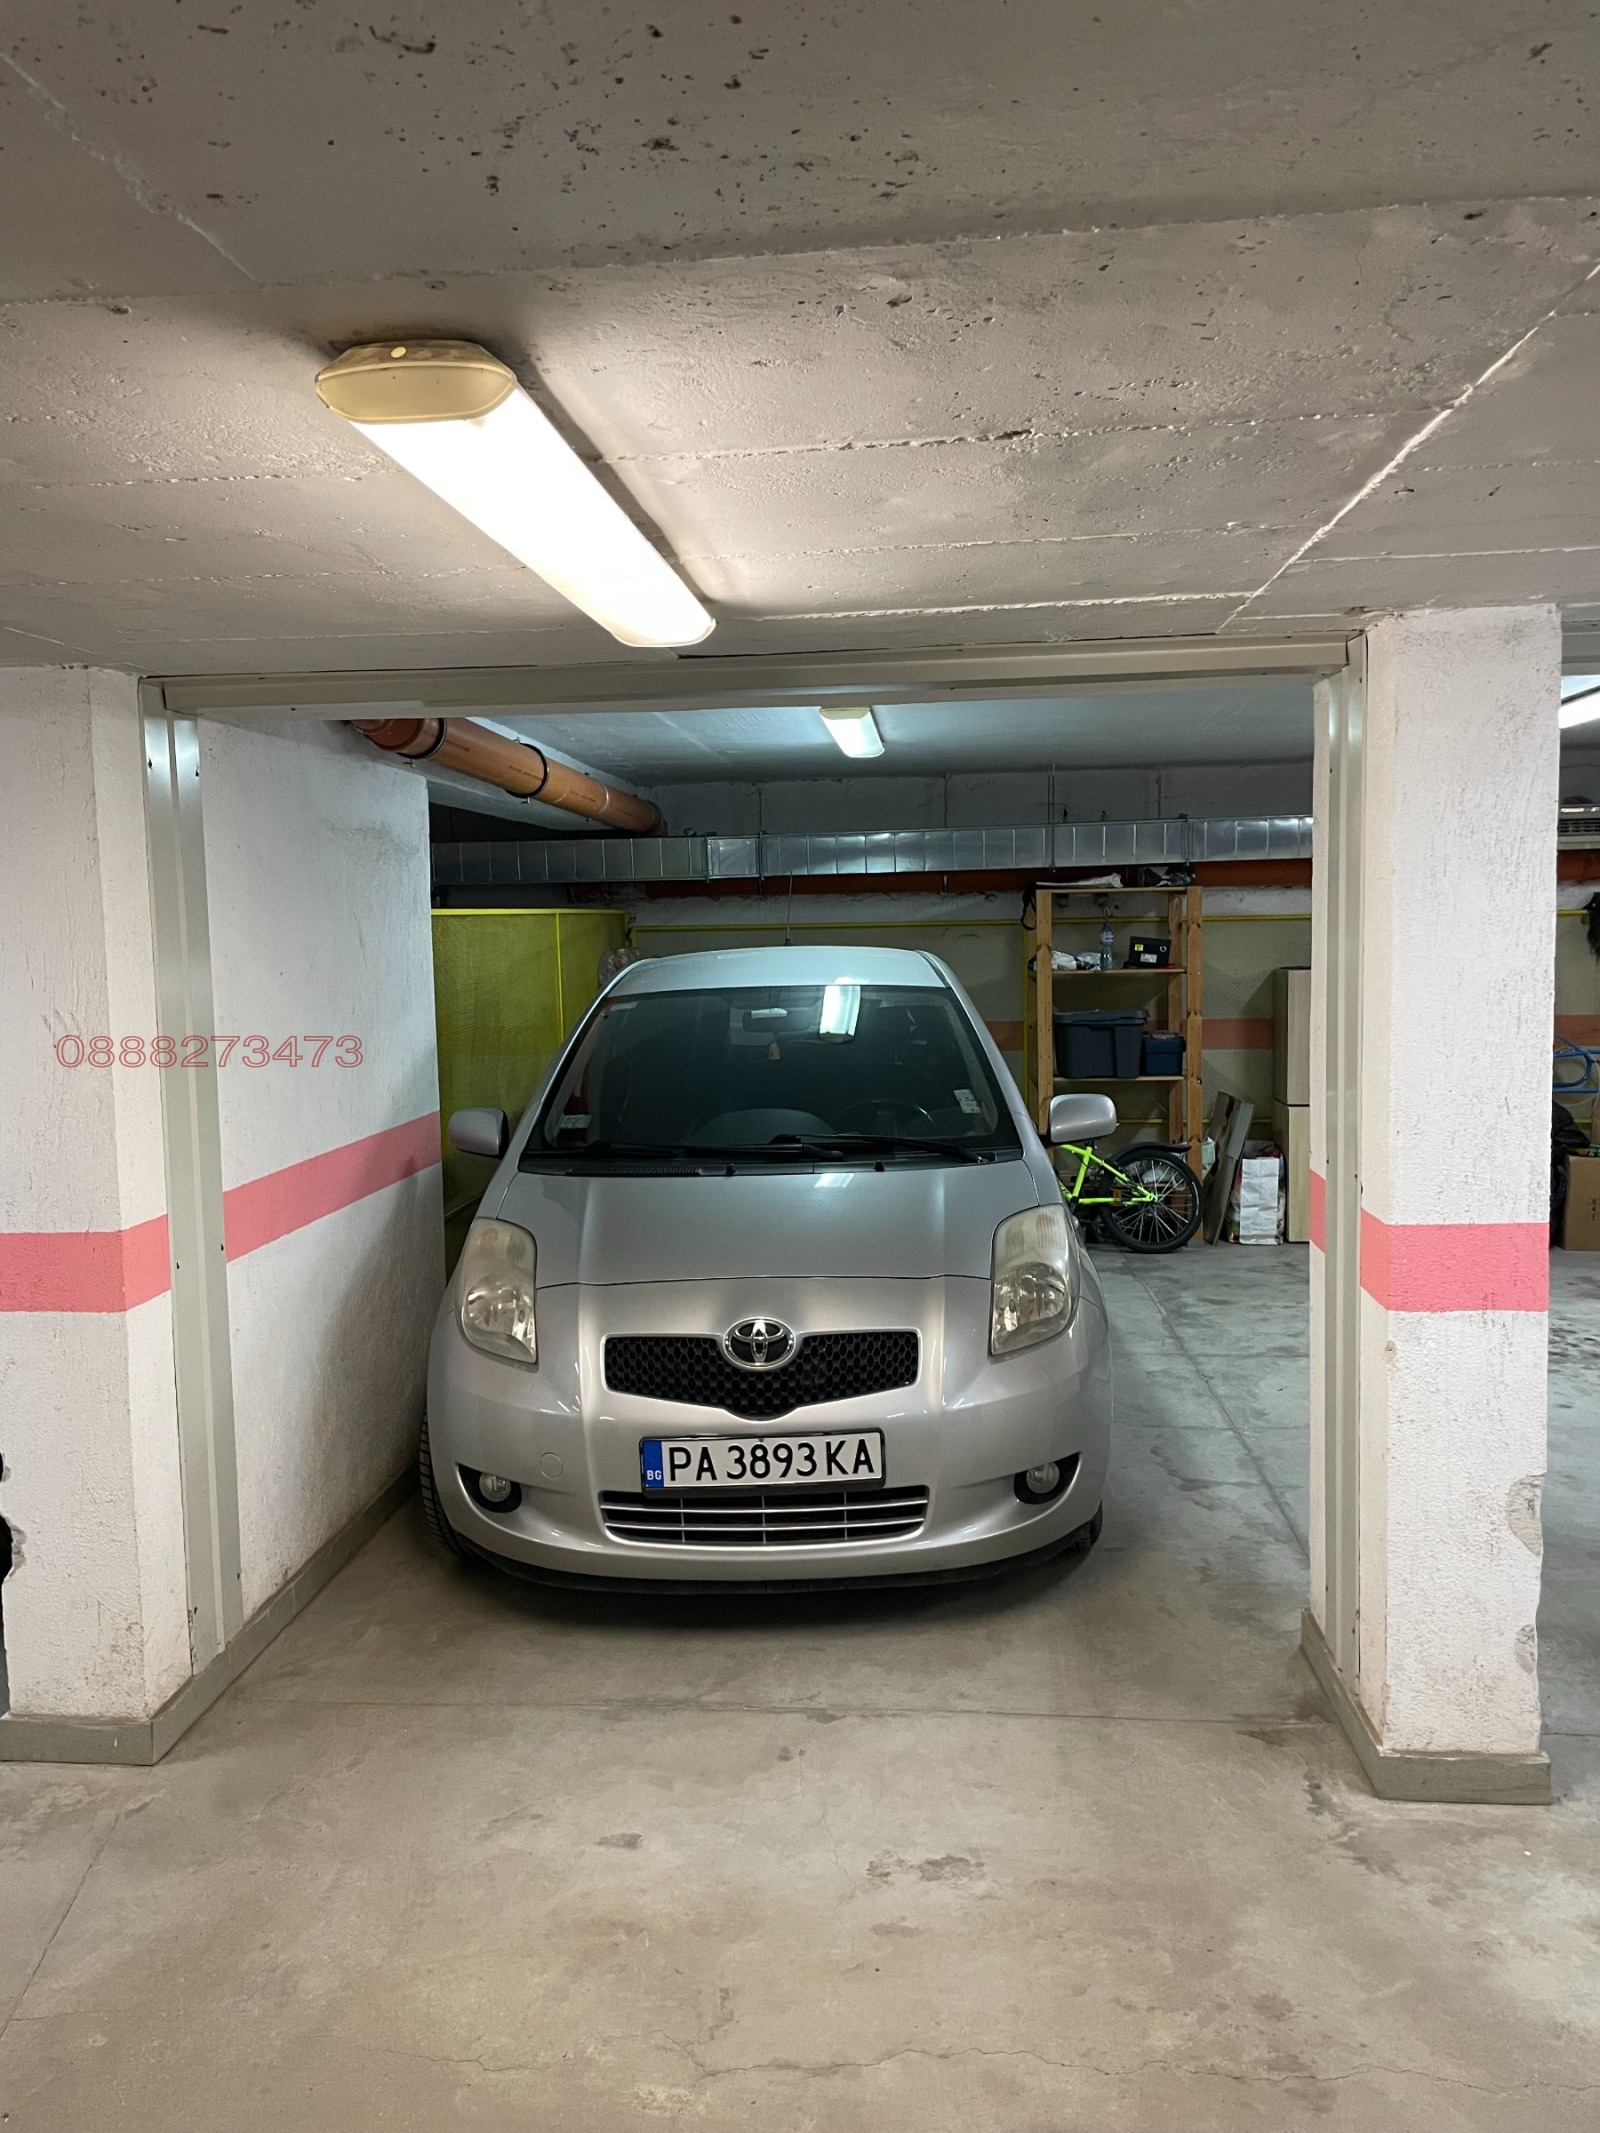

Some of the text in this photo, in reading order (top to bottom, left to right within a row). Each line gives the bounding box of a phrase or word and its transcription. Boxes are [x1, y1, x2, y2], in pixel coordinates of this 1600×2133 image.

[669, 1439, 875, 1481] PA 3893 KA
[647, 1469, 662, 1480] BG
